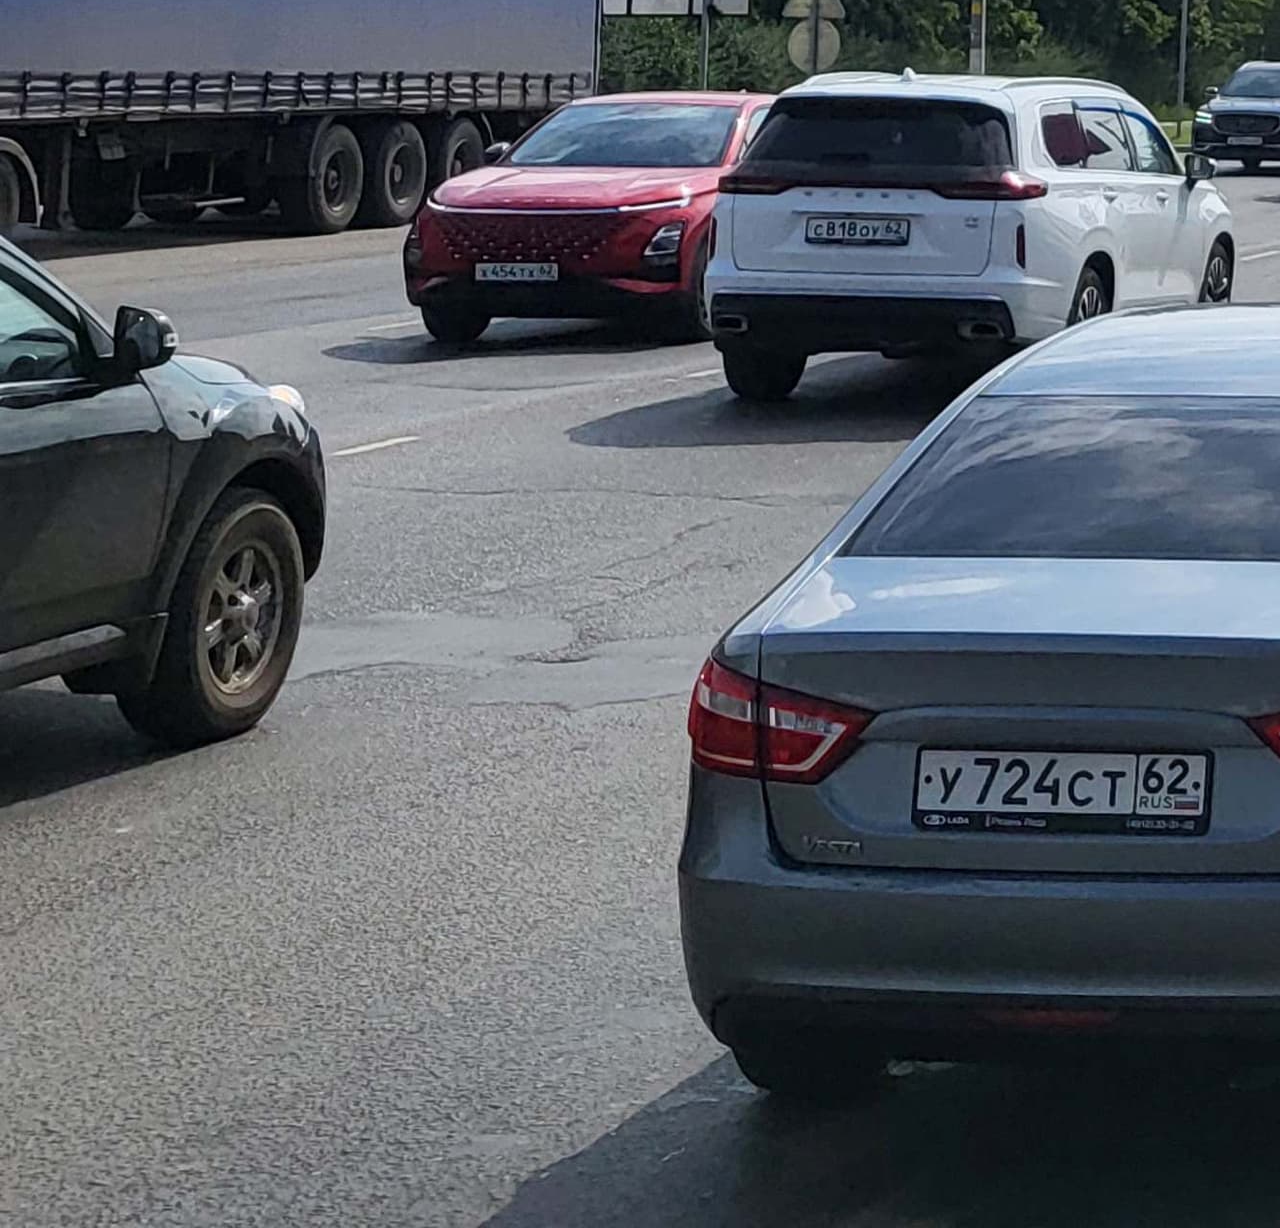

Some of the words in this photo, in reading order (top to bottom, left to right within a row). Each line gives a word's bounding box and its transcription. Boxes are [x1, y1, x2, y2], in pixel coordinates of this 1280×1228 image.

[885, 222, 902, 235] 62
[1142, 757, 1190, 795] 62
[1138, 795, 1174, 810] RUS
